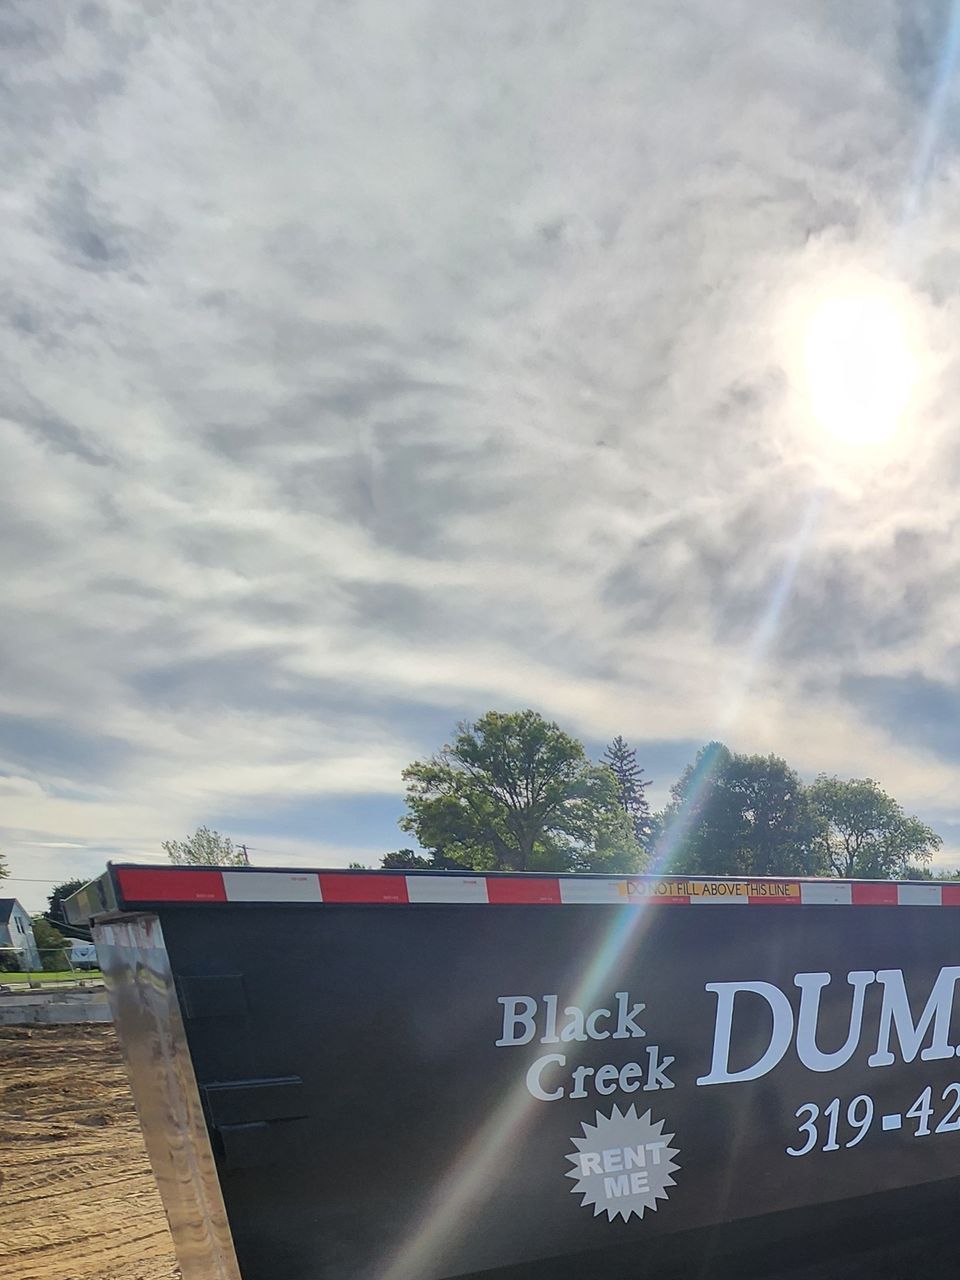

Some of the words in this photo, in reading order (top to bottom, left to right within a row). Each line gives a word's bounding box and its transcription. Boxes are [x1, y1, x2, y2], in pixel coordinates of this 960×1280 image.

[627, 882, 645, 895] DO
[677, 883, 699, 895] FILL
[702, 883, 741, 896] ABOVE
[744, 883, 767, 896] THIS
[769, 884, 790, 896] LINE
[495, 991, 646, 1047] Black
[526, 1045, 676, 1101] Creek
[580, 1141, 666, 1177] RENT
[604, 1171, 650, 1199] ME
